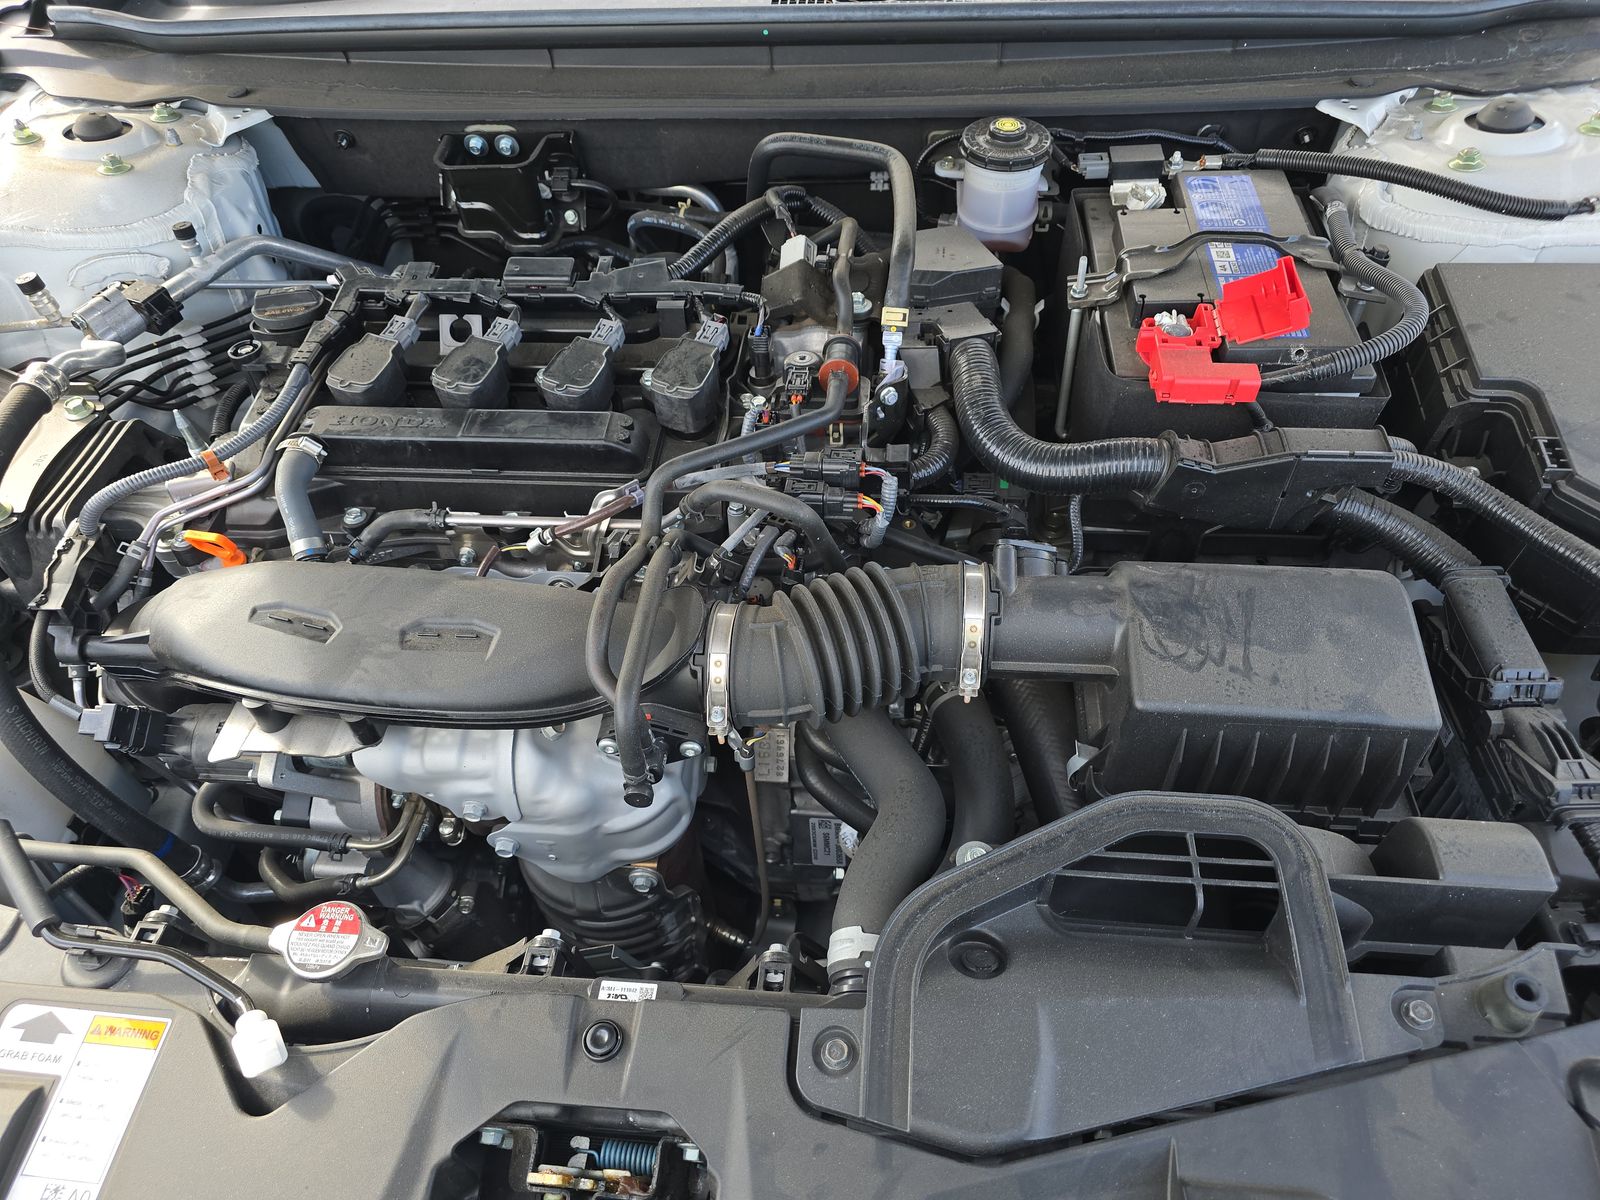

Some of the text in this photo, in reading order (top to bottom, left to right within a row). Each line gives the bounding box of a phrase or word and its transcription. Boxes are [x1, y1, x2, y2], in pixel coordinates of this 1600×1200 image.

[329, 414, 447, 429] HONDA
[322, 906, 350, 914] DANGER
[104, 1025, 160, 1041] WARNING
[31, 1052, 63, 1063] FOAM
